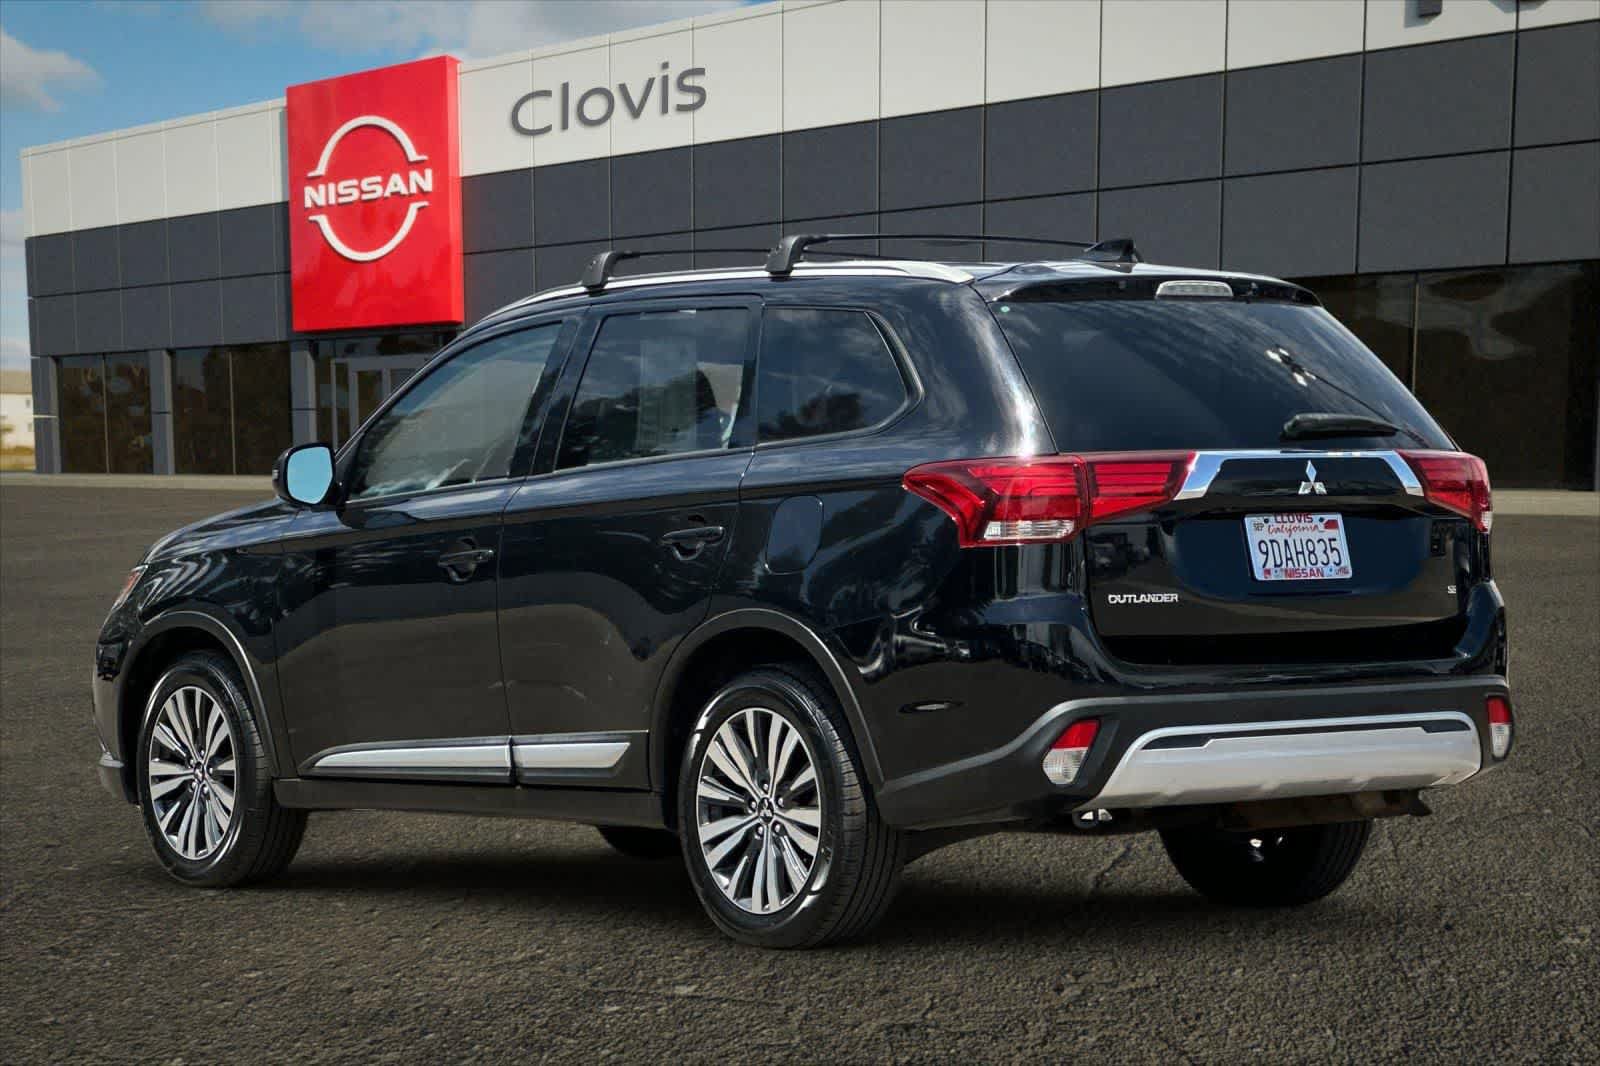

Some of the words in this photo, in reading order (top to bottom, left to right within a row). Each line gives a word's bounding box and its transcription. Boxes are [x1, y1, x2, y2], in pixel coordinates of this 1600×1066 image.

[511, 61, 707, 136] Clovis
[303, 168, 433, 209] NISSAN
[1267, 524, 1319, 537] California
[1257, 538, 1342, 569] 9DAH835
[1284, 567, 1325, 578] NISSAN
[1107, 593, 1179, 604] OUTLANDER
